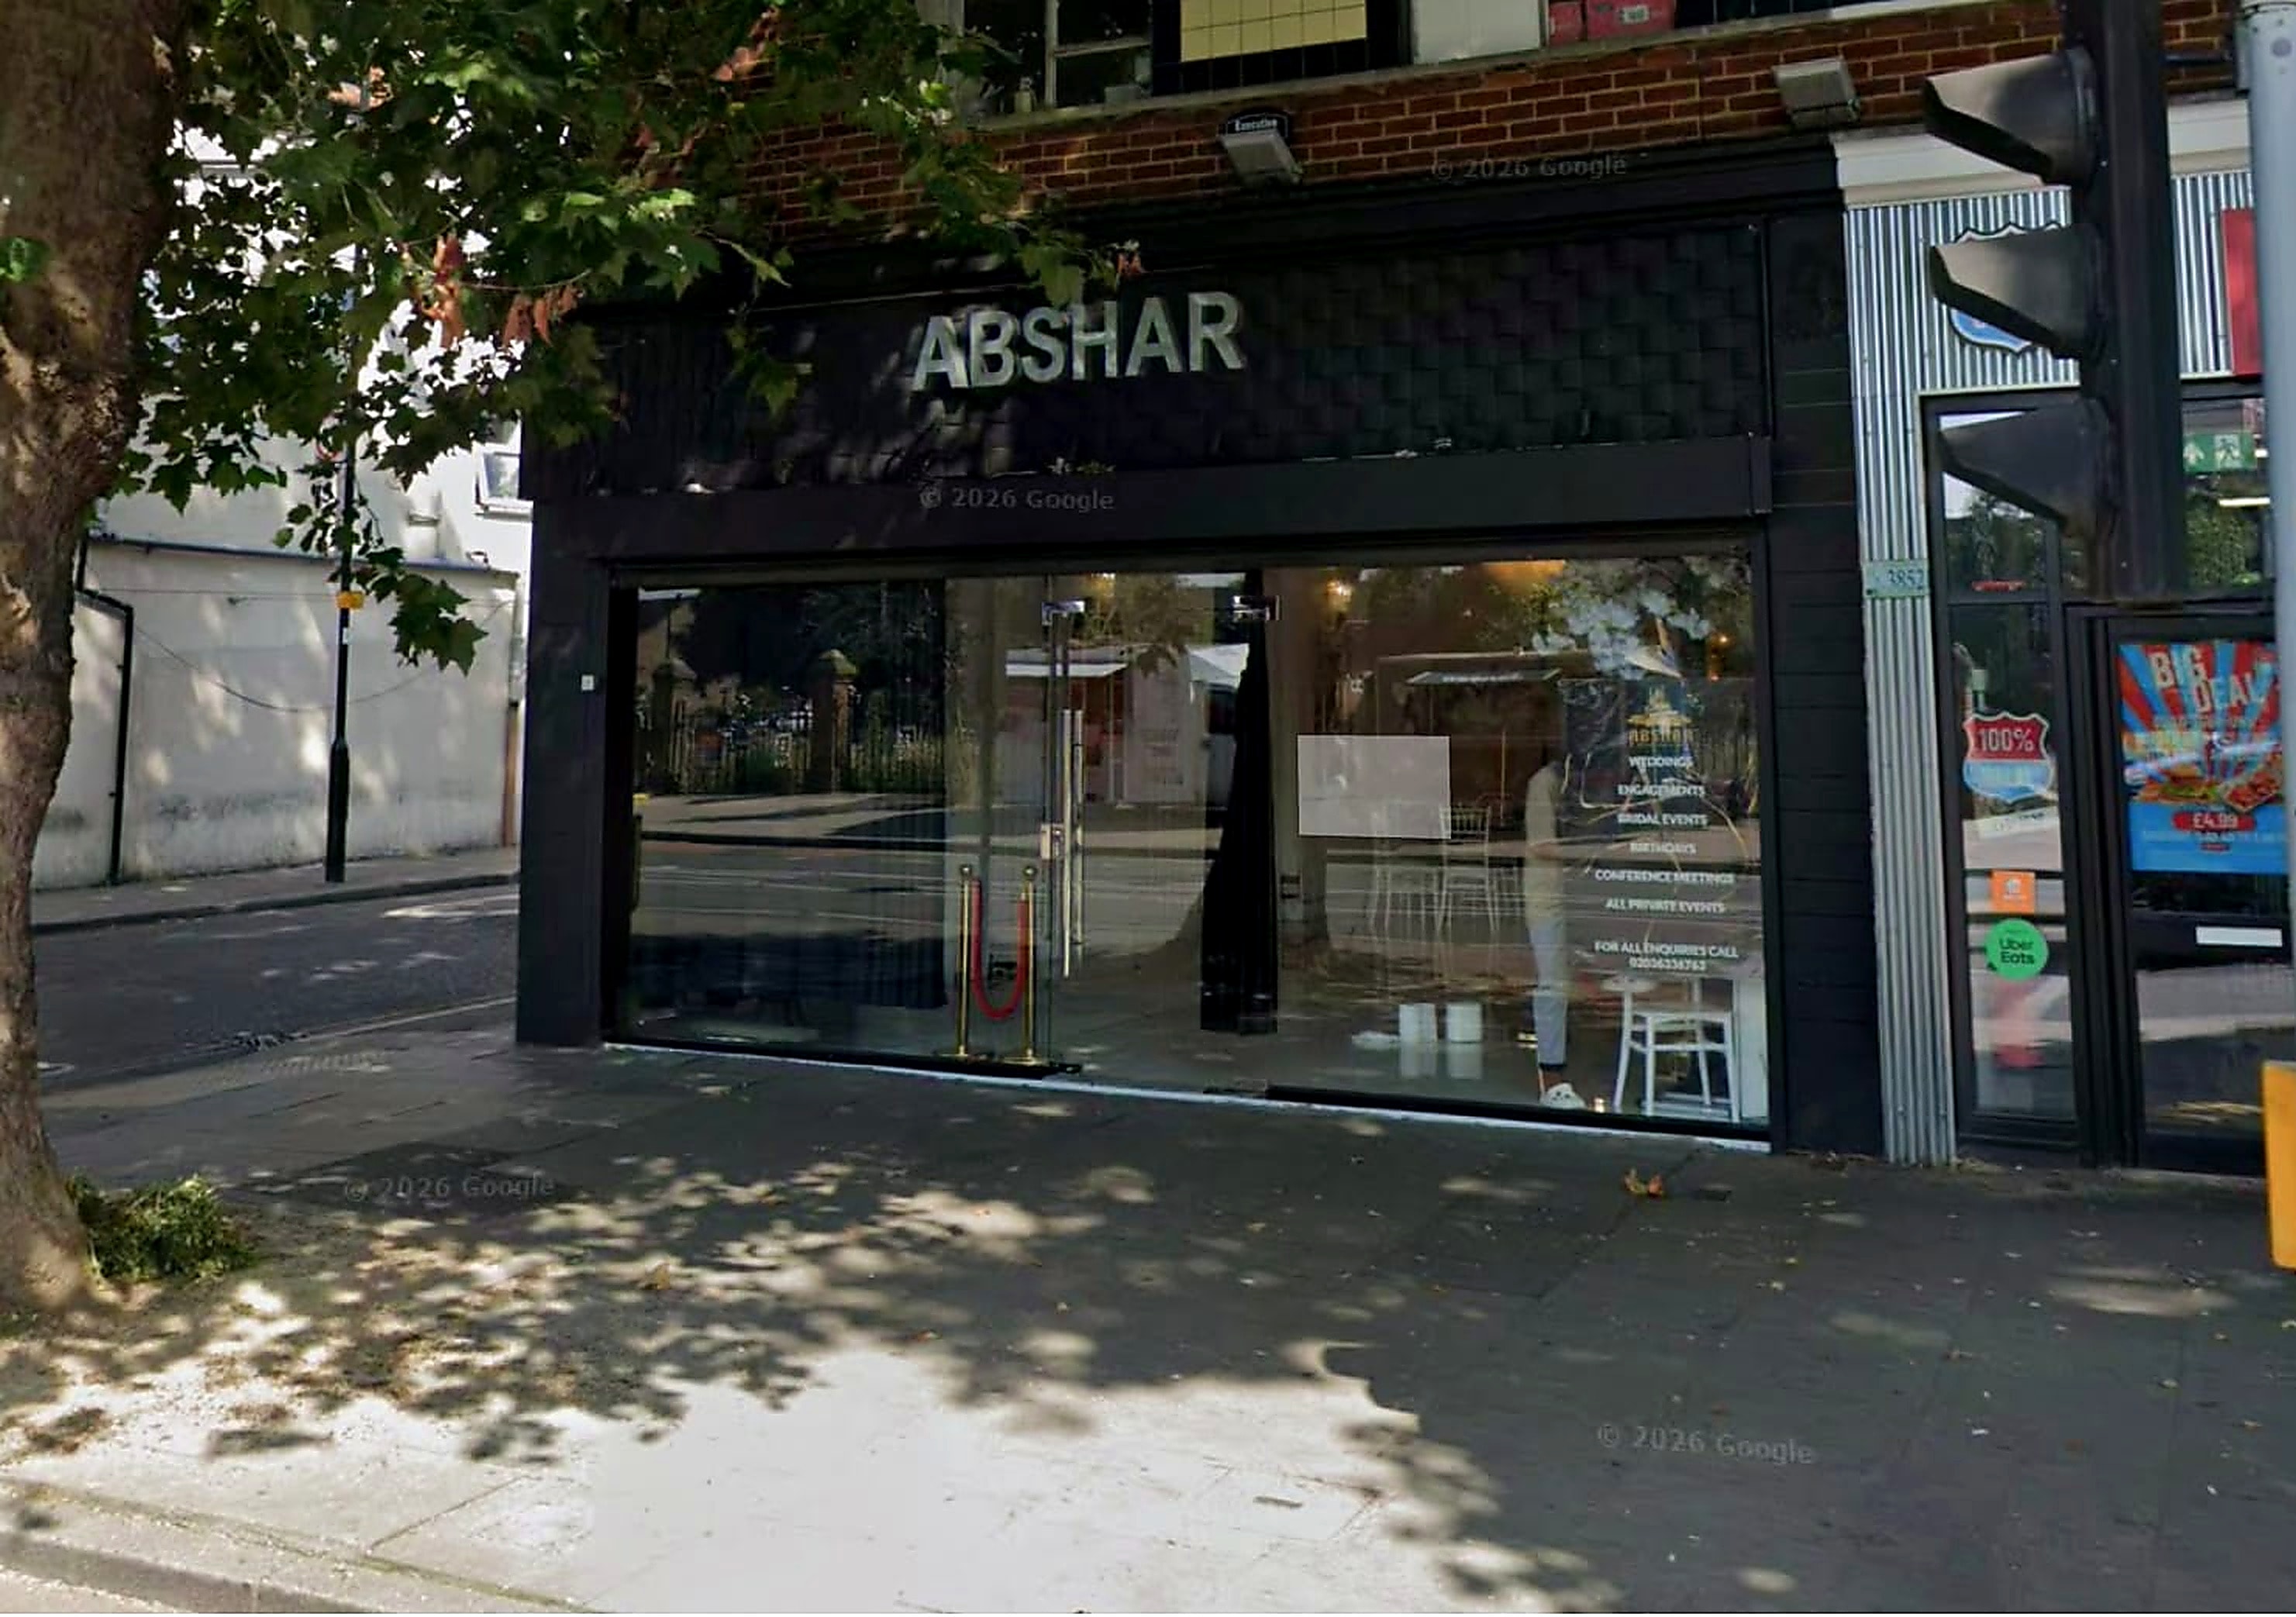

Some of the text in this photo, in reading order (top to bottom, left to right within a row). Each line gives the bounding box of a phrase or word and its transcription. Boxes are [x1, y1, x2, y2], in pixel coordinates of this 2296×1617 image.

[913, 291, 1244, 389] ABSHAR
[2148, 645, 2212, 689] BIG
[1981, 728, 2035, 752] 100%
[1629, 757, 1694, 767] WEDDINGS
[1618, 784, 1705, 797] ENGAGEMENTS
[1617, 814, 1708, 827] BRIDAL EVENTS
[1630, 843, 1697, 854] BIRTHDAYS
[1594, 868, 1736, 884] CONFERENCE MEETINGS
[1605, 898, 1726, 914] ALL PRIVATE EVENTS
[1594, 941, 1739, 959] FOR ALL ENQUIRIES CALL
[1998, 937, 2034, 950] Uber
[2000, 950, 2035, 965] Eats
